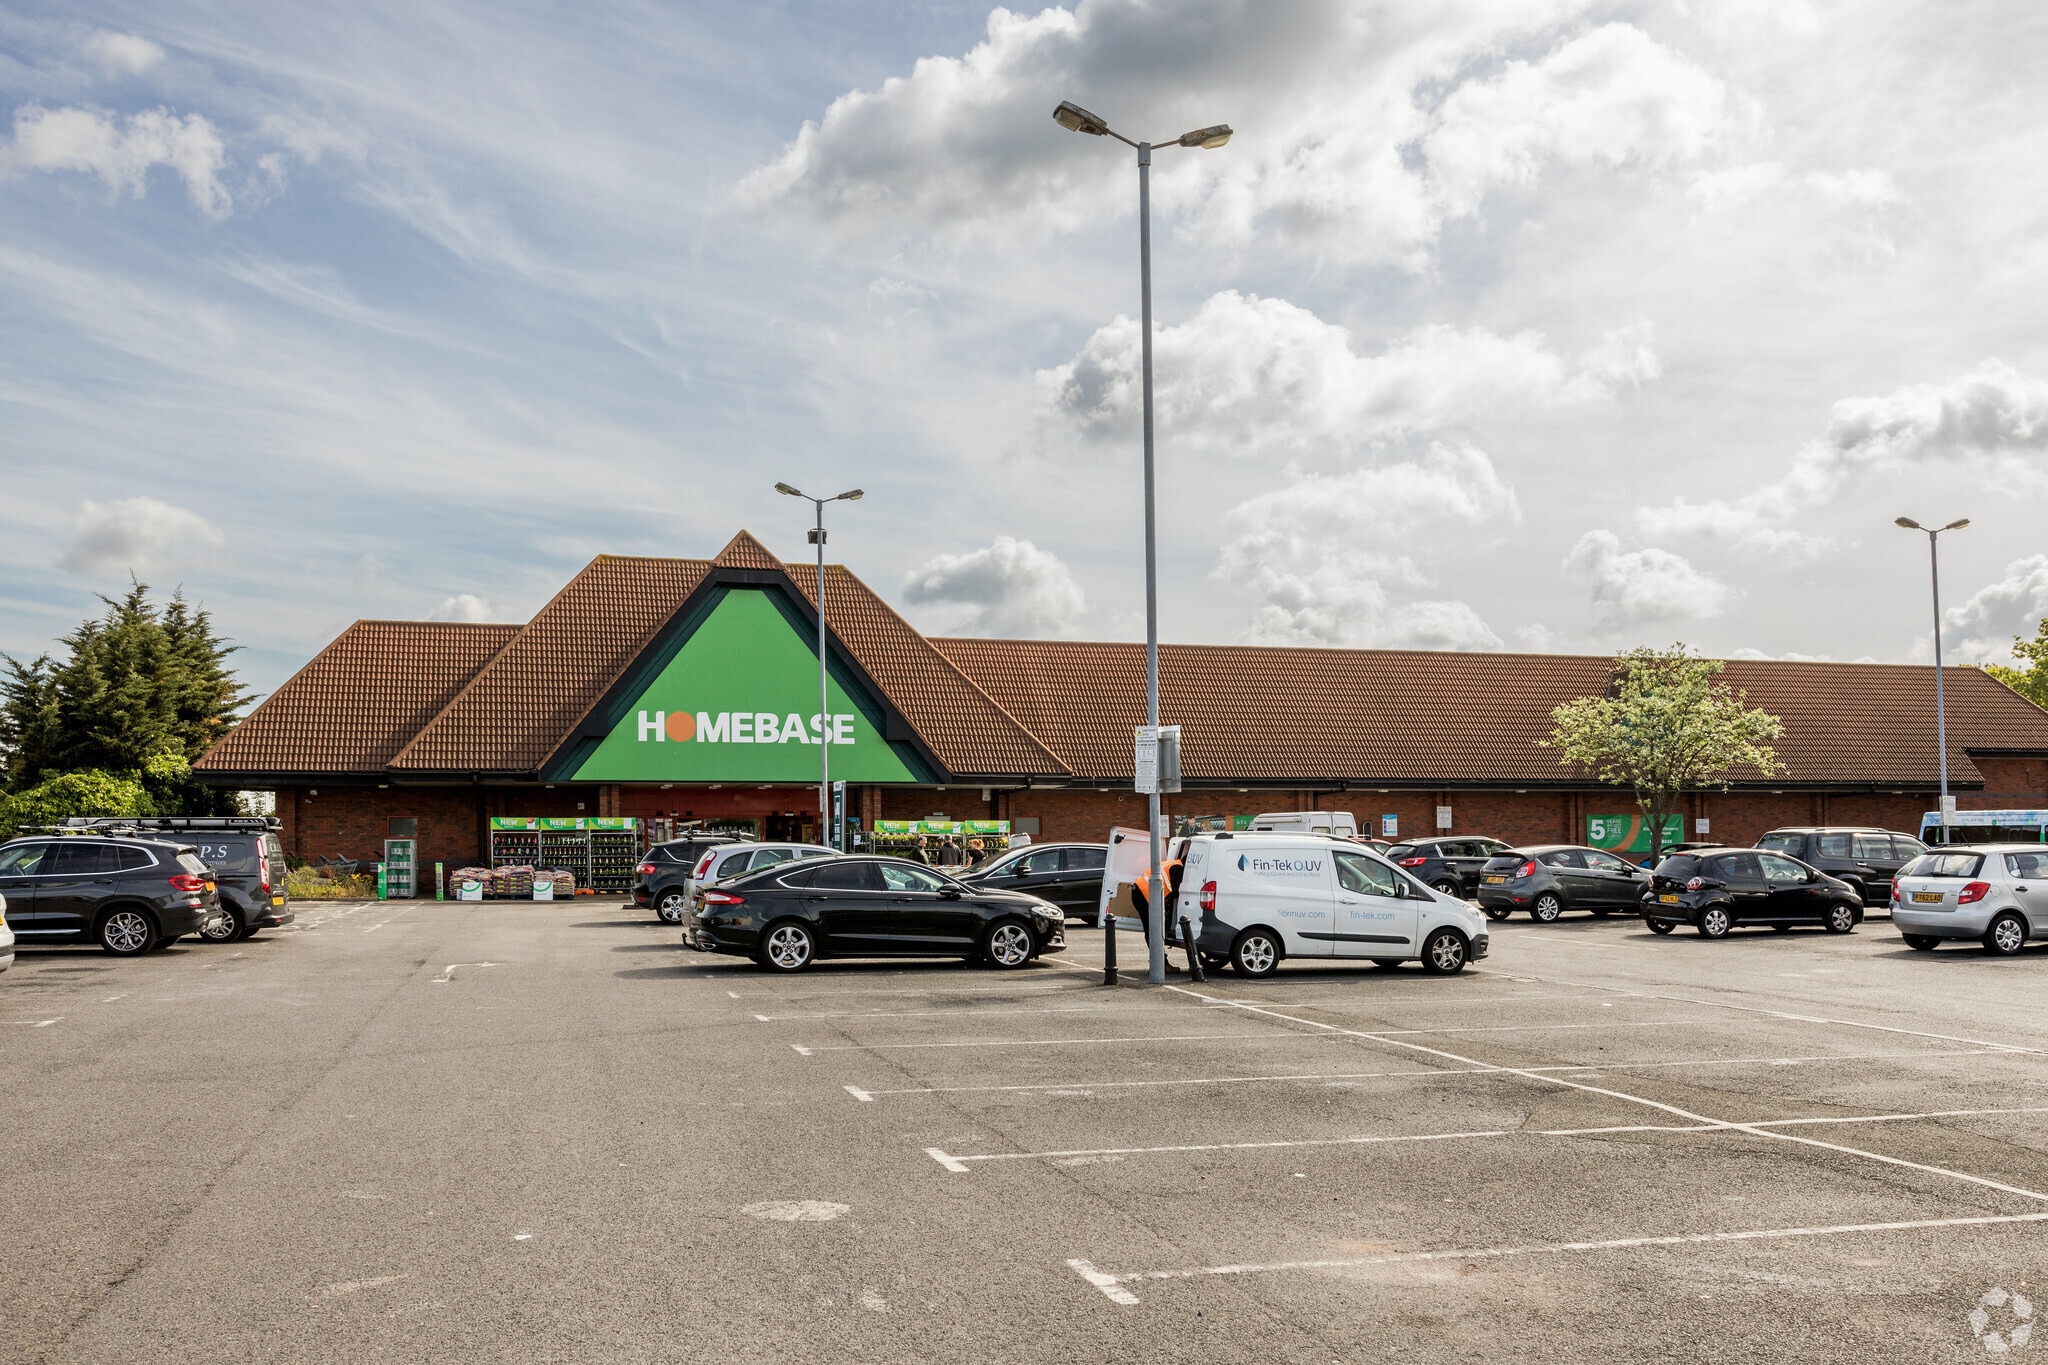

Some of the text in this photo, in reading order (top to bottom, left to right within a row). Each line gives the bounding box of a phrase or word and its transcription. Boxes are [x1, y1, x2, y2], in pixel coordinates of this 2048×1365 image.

[638, 711, 855, 744] HOMEBASE
[500, 818, 518, 826] NEW
[598, 818, 614, 826] NEW
[1590, 819, 1606, 840] 5
[1253, 859, 1292, 871] Fin-Tek
[1350, 910, 1395, 920] fin-tek.com
